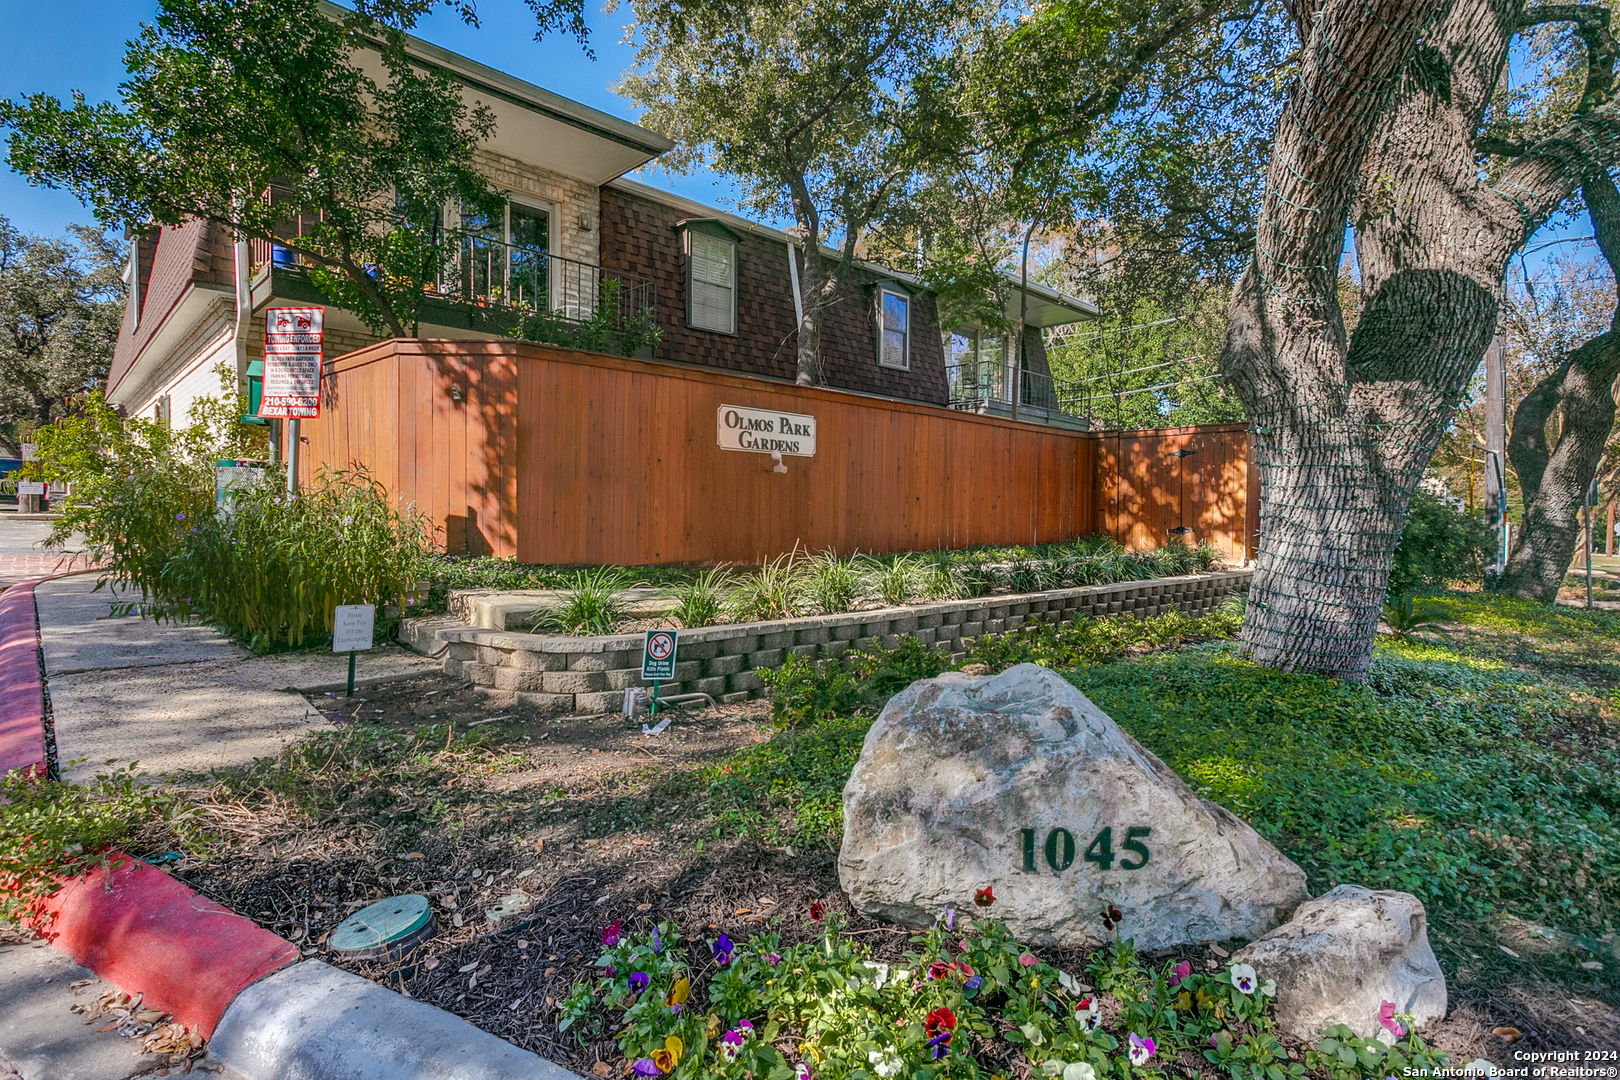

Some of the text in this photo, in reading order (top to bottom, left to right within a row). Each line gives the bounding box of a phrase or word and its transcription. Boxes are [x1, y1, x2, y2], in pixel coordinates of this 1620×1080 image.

[268, 334, 320, 343] TOWING ENFORCED
[264, 397, 317, 406] 210-590-6200
[262, 406, 317, 416] BEXAR TOWING
[724, 410, 811, 436] OLMOS PARK
[738, 430, 799, 452] GARDENS
[1020, 826, 1152, 872] 1045
